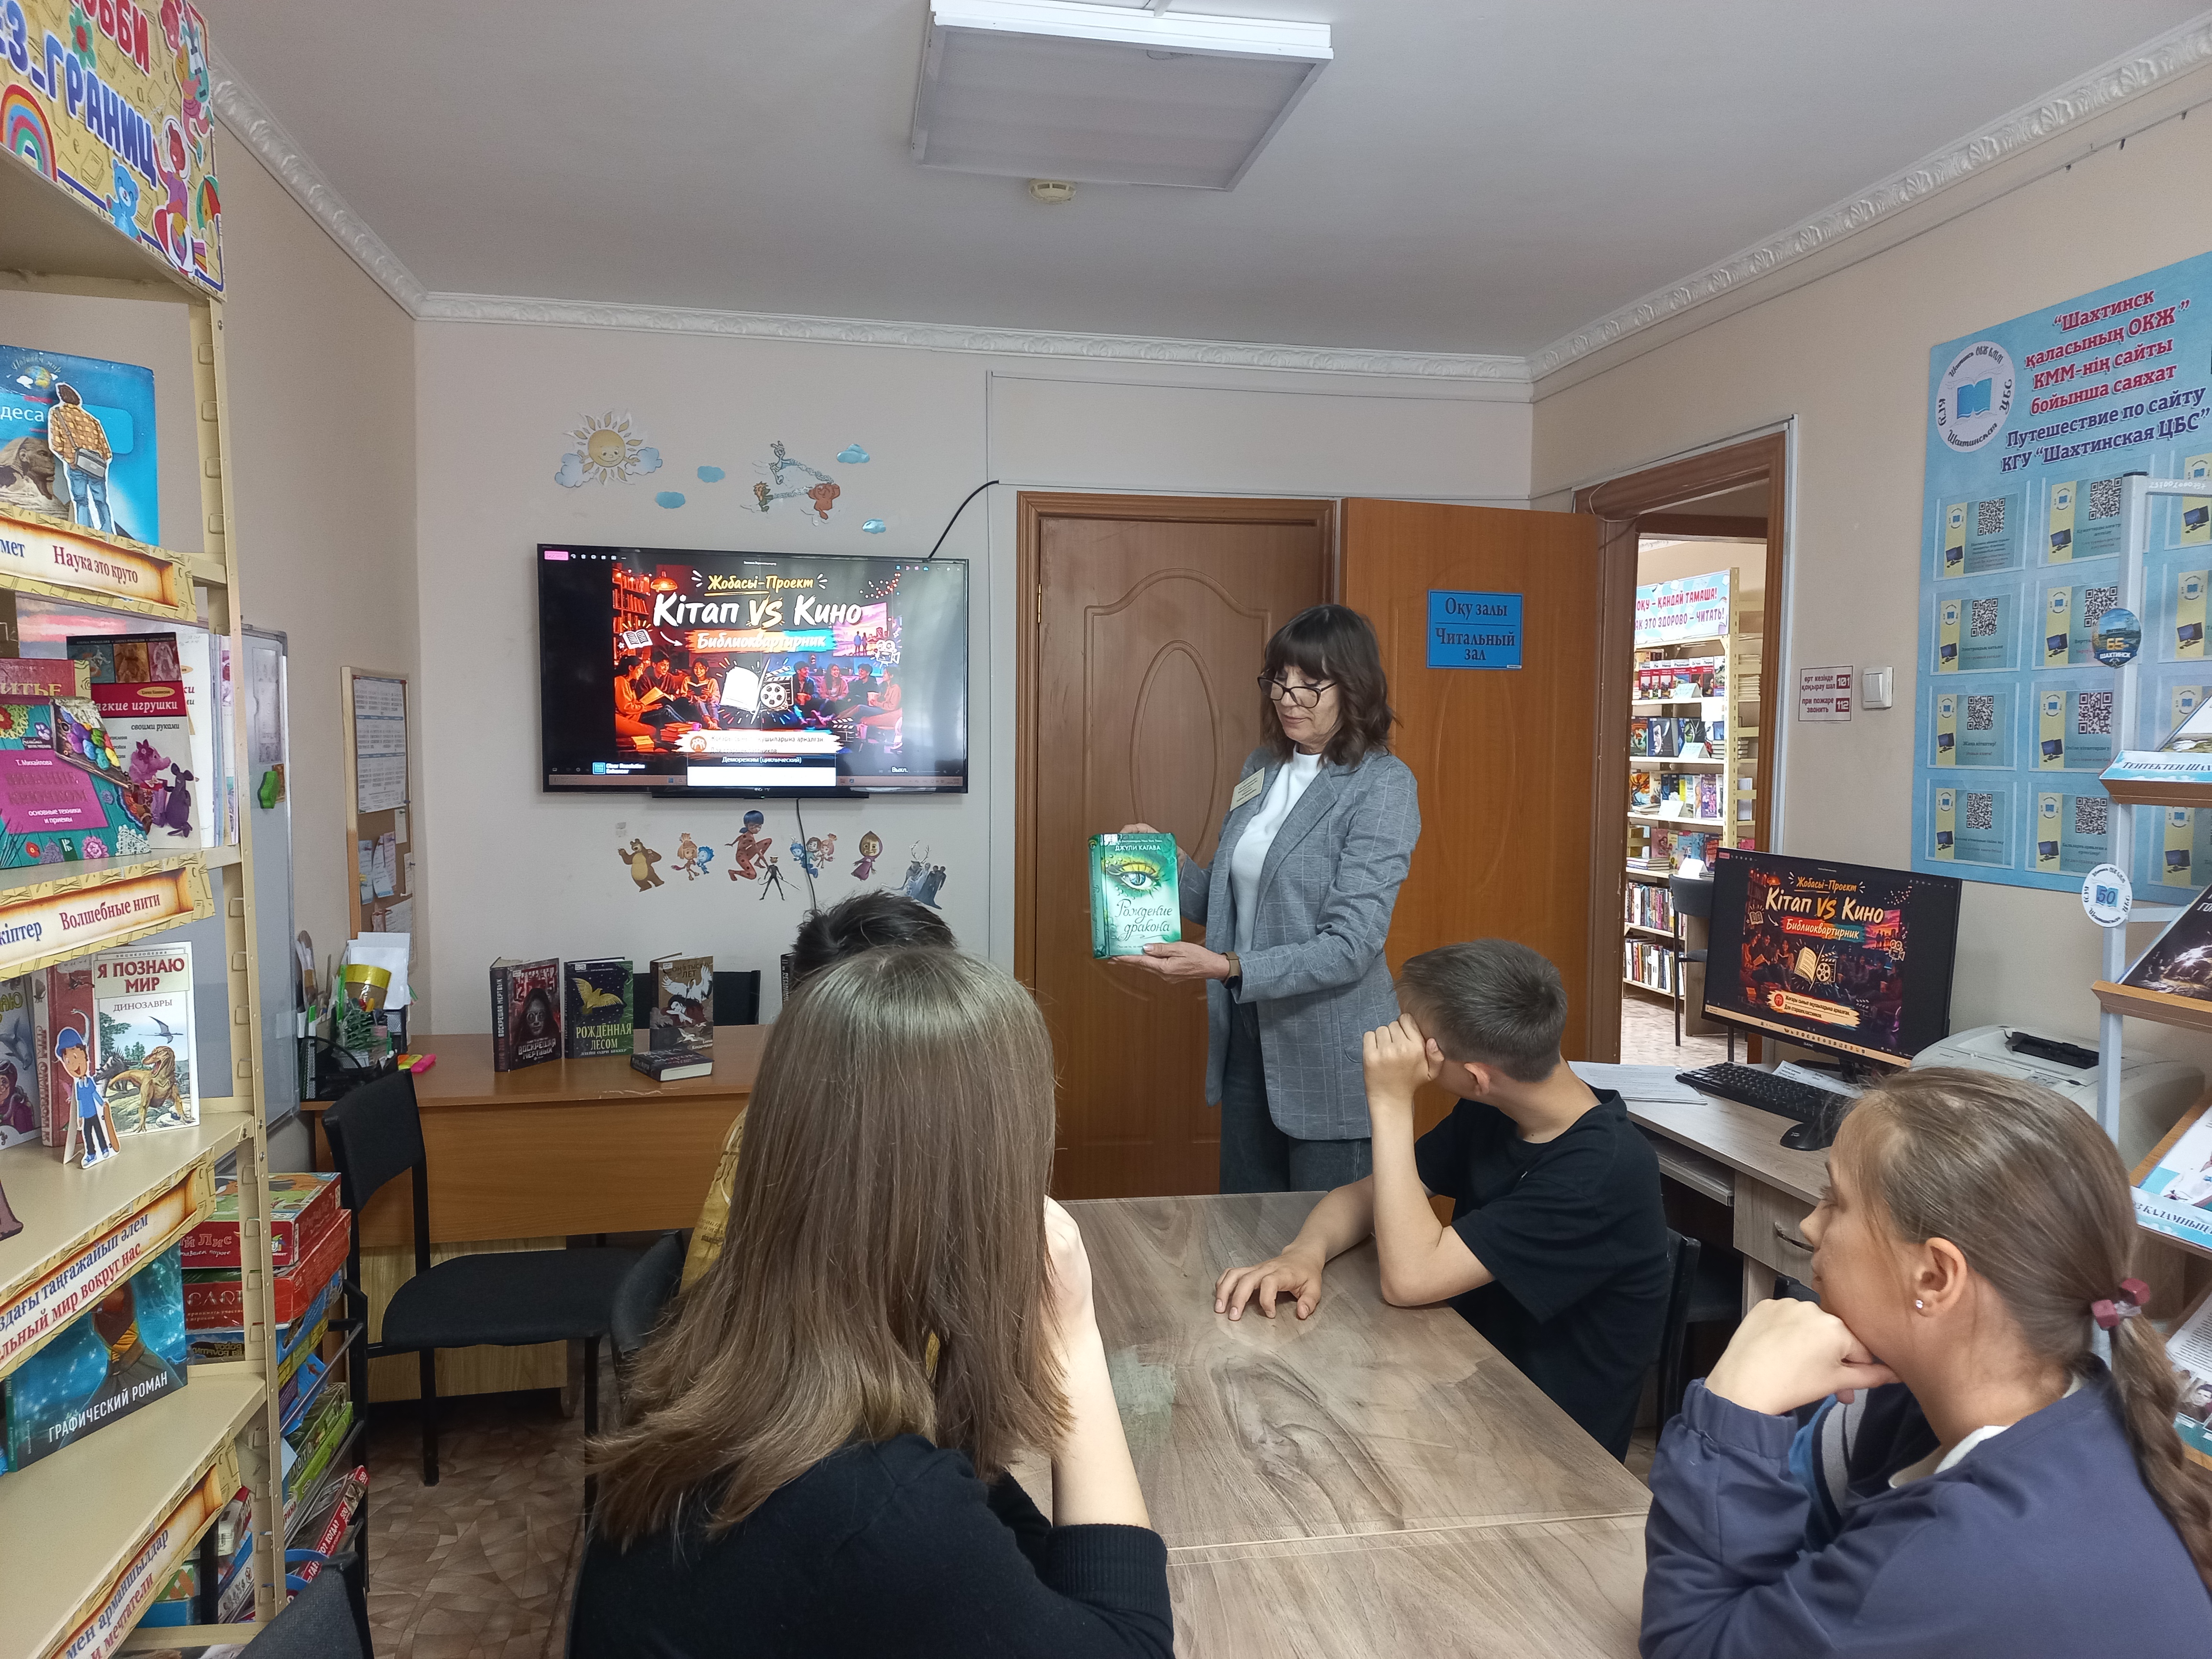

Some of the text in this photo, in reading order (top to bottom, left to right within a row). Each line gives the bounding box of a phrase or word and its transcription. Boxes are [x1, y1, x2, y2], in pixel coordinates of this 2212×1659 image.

[0, 0, 157, 188] З_ГРАНИЦ
[2024, 326, 2125, 369] қаласының
[2128, 306, 2177, 337] ОКЖ
[2032, 339, 2174, 390] КММ-нің сайты
[2031, 364, 2178, 415] бойынша саяхат
[0, 406, 44, 422] деса
[2007, 387, 2207, 449] Путешествие по сайту
[2001, 450, 2033, 473] КГУ
[2035, 427, 2155, 465] “Шахтинская
[53, 545, 94, 573] Наука
[94, 561, 110, 577] это
[111, 564, 138, 585] круто
[653, 591, 862, 629] Кітап VS Кино
[1445, 597, 1507, 620] Оқу залы
[1637, 587, 1717, 612] ОҚУ ҚАНДАЙ ТАМАША!
[1645, 618, 1657, 630] ЭТО
[1658, 613, 1688, 628] ЗДОРОВО
[1696, 608, 1725, 623] ЧИТАТЬ!
[697, 631, 827, 654] Библиоквартирник
[1435, 627, 1515, 646] Читальный
[2106, 637, 2125, 651] 65
[1464, 649, 1486, 661] зал
[1814, 674, 1834, 682] кезінде
[1837, 677, 1850, 686] 101
[132, 700, 178, 714] игрушки
[1813, 697, 1834, 706] пожаре
[1837, 700, 1849, 710] 112
[156, 723, 180, 731] руками
[2122, 762, 2185, 771] ТЕНТЕКТЕН
[49, 817, 73, 825] приемы
[1765, 886, 1885, 924] Кітап VS Кино
[2097, 889, 2116, 905] 50
[59, 898, 132, 930] Волшебные
[133, 894, 161, 915] нити
[1115, 898, 1172, 924] Рождение
[1117, 919, 1170, 941] дракона
[1786, 918, 1860, 941] Библиоквартирник
[97, 958, 185, 979] Я ПОЗНАЮ
[682, 970, 697, 978] ЛЕТ
[124, 976, 160, 994] МИР
[113, 999, 173, 1012] ДИНОЗАВРЫ
[36, 1025, 48, 1059] МИР
[576, 1023, 631, 1039] РОЖДЁННАЯ
[518, 1038, 556, 1055] ВОСКРЕШАЯ
[591, 1038, 618, 1051] ЛЕСОМ
[198, 1233, 232, 1248] Лис
[42, 1235, 119, 1302] таңғажайып
[121, 1213, 149, 1242] әлем
[52, 1292, 79, 1323] мир
[80, 1259, 122, 1299] вокруг
[123, 1242, 141, 1271] нас
[49, 1388, 129, 1443] ГРАФИЧЕСКИЙ
[132, 1371, 168, 1402] РОМАН
[340, 1507, 348, 1519] 500
[325, 1519, 340, 1545] КОГДА?
[98, 1529, 169, 1630] арманшылдар
[103, 1572, 154, 1651] мечтатели
